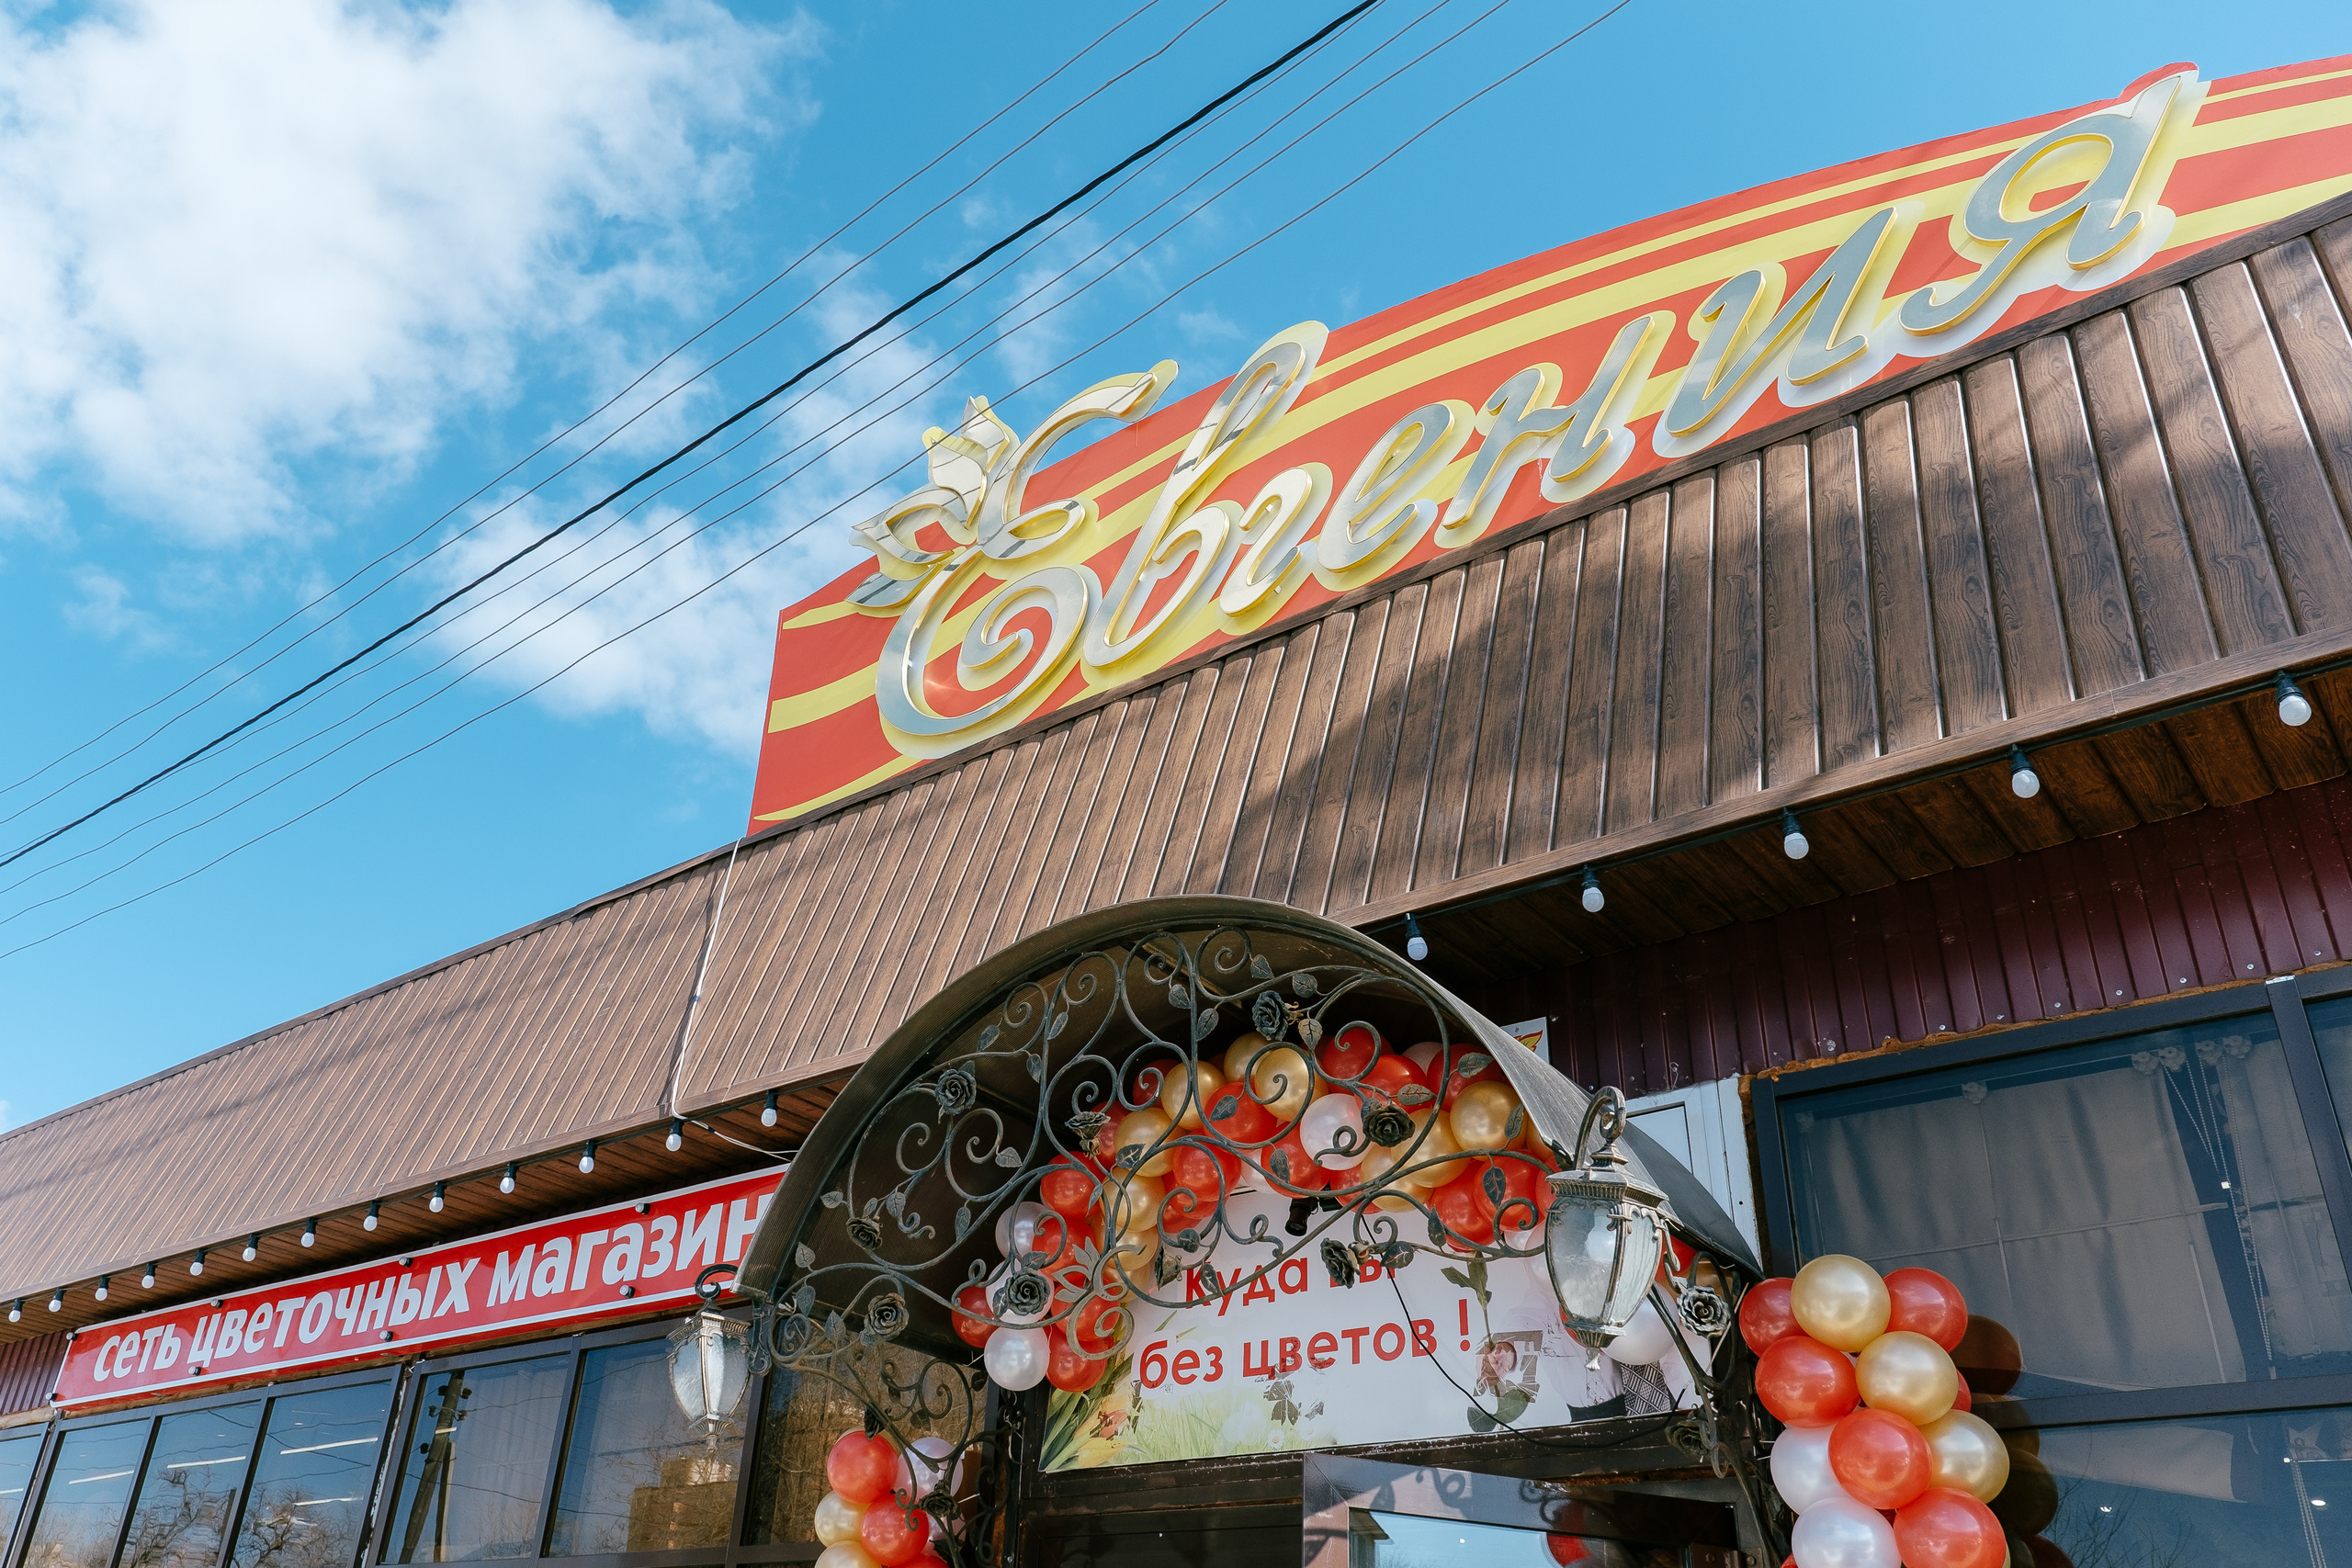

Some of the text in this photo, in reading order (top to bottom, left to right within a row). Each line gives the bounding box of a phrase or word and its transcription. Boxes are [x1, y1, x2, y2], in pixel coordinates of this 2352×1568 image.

[862, 72, 2187, 739] Евгения
[93, 1323, 182, 1382] сеть
[187, 1257, 481, 1368] цветочных
[1138, 1338, 1225, 1390] без
[1242, 1318, 1438, 1381] цветов
